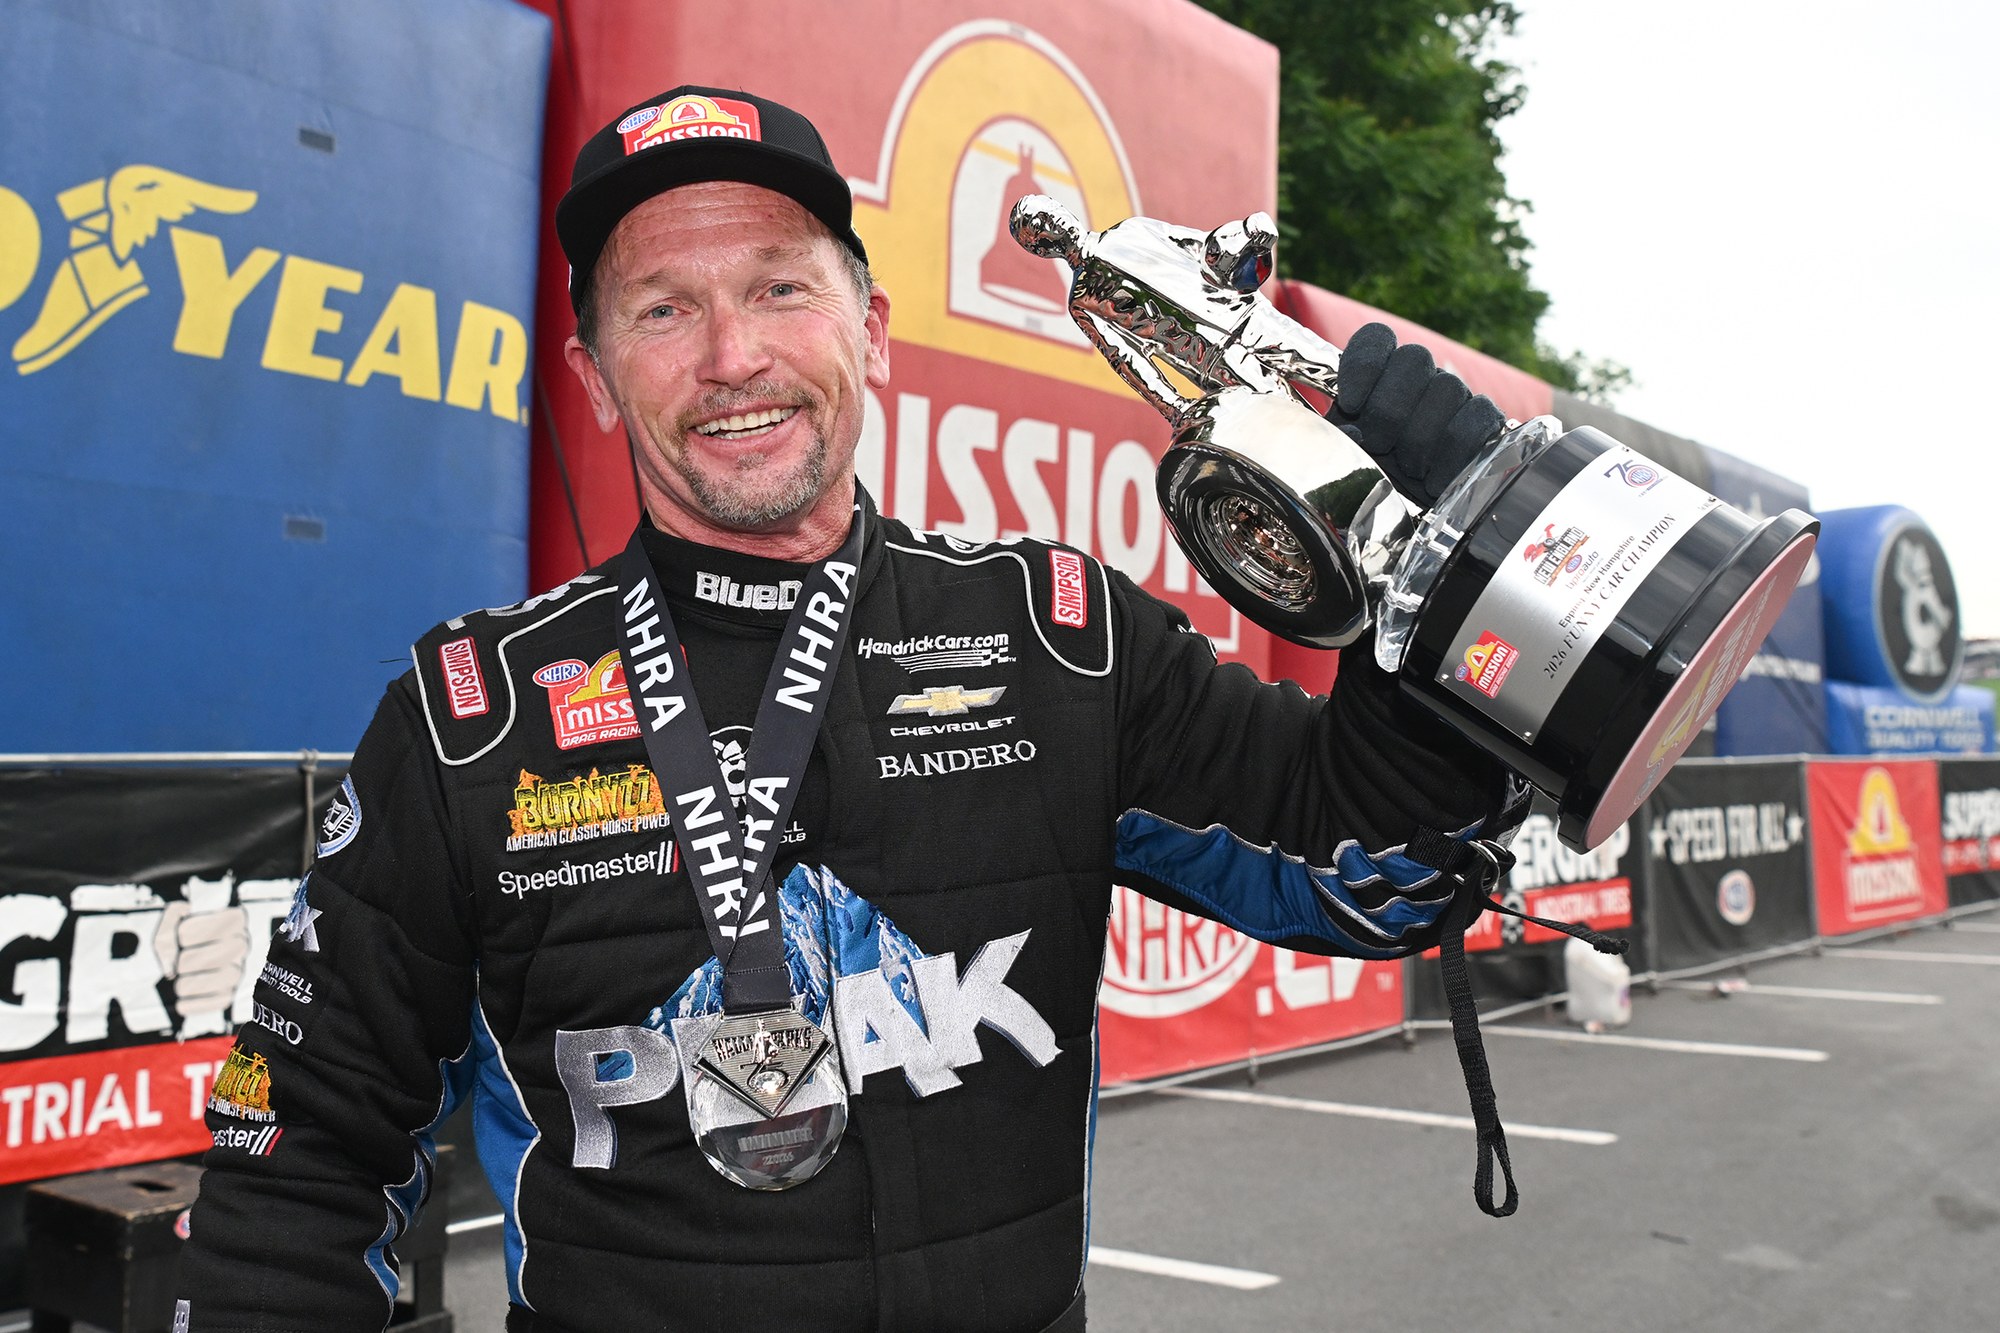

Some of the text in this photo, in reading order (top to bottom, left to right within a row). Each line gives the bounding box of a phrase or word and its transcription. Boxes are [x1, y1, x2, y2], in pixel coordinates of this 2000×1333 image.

[170, 226, 528, 423] YEAR
[1055, 554, 1081, 621] SIMPSON
[1583, 575, 1601, 594] New
[1599, 535, 1635, 576] Hampshire
[1543, 649, 1567, 679] 2026
[1599, 571, 1624, 600] CAR
[1621, 513, 1676, 572] CHAMPION
[623, 577, 687, 732] NHRA
[775, 561, 857, 713] NHRA
[858, 634, 1009, 659] HendrickCars.com
[446, 641, 483, 708] SIMPSON
[542, 664, 581, 682] NHRA
[1478, 646, 1509, 689] MISSION
[562, 725, 642, 748] DRAG RACIN
[890, 717, 1016, 737] CHEVROLET
[876, 740, 1037, 779] BANDERO
[506, 833, 559, 852] AMERICAN
[559, 824, 600, 844] CLASSIC
[601, 819, 633, 837] HORSE
[498, 851, 657, 900] Speedmaster
